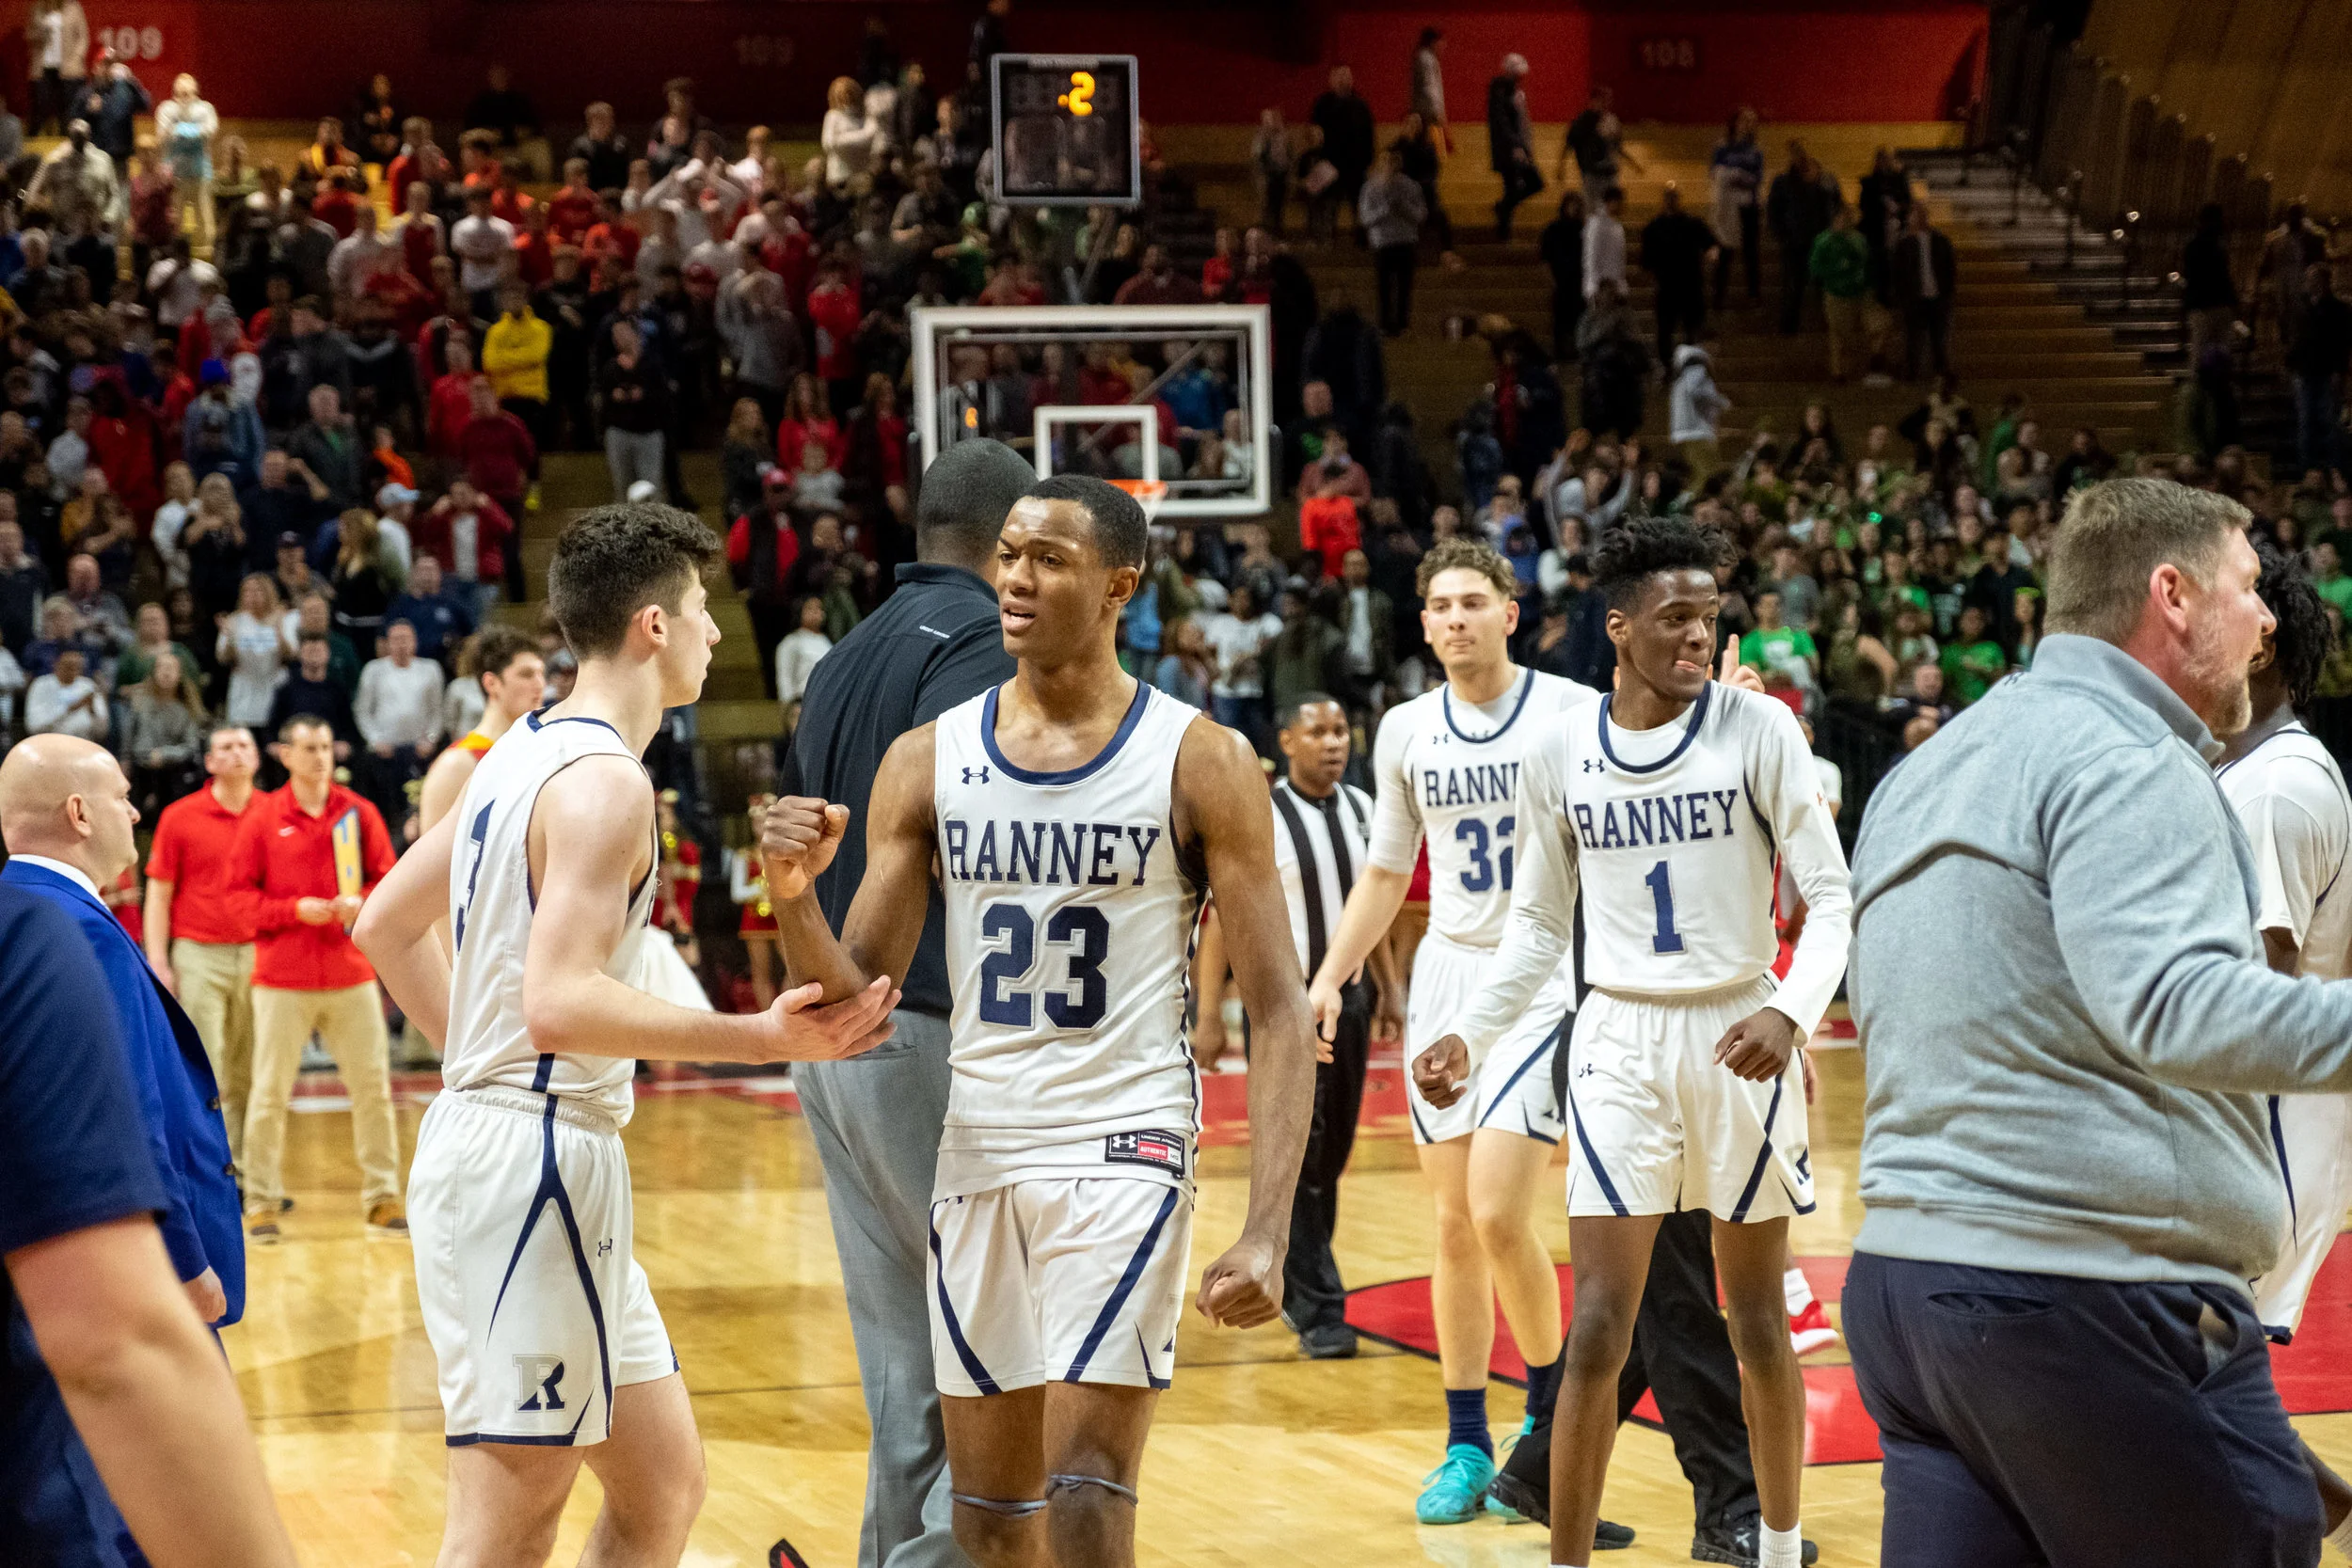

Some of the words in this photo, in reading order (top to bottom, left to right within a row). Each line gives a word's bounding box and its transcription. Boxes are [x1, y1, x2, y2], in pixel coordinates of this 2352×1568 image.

[97, 25, 164, 60] 109
[1423, 762, 1520, 807] RANN
[1573, 788, 1738, 848] RANNEY
[944, 818, 1163, 887] RANNEY
[1645, 860, 1687, 954] 1
[978, 902, 1110, 1030] 23
[1139, 1146, 1168, 1157] AUTHENTIC
[512, 1354, 566, 1413] R
